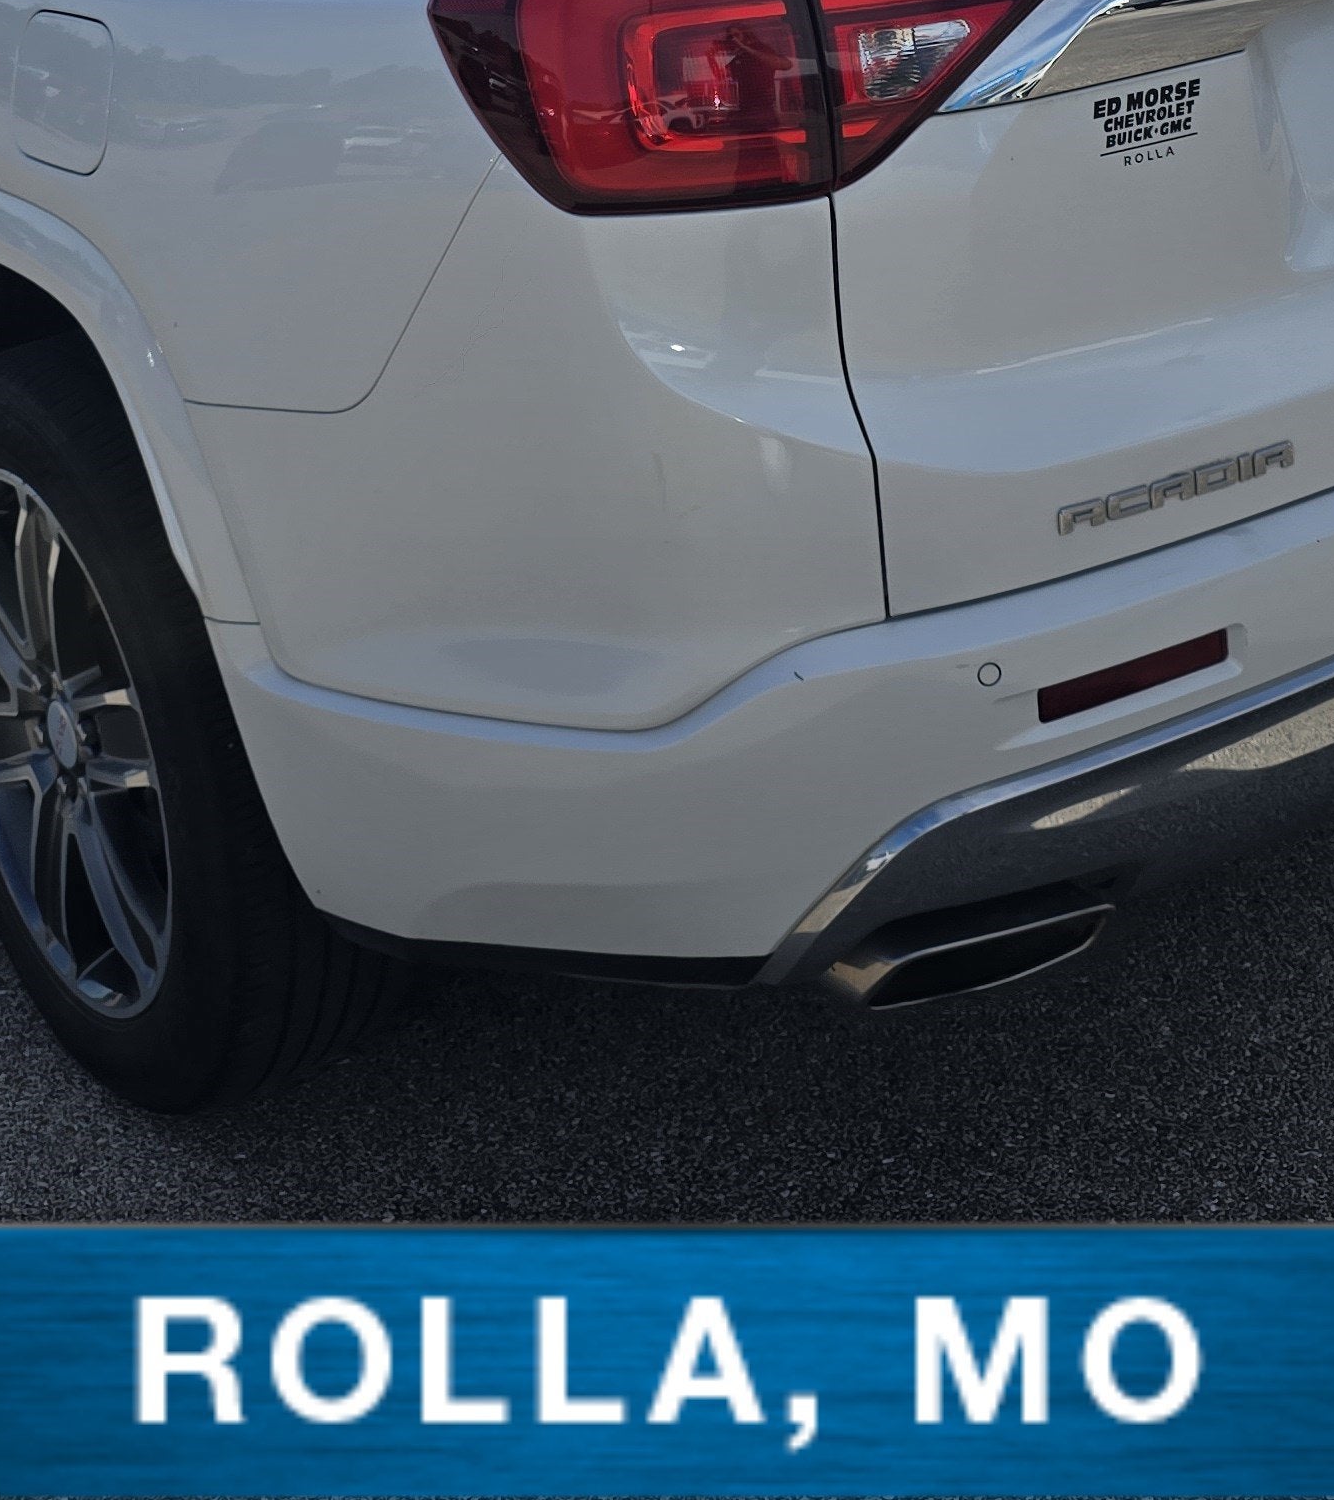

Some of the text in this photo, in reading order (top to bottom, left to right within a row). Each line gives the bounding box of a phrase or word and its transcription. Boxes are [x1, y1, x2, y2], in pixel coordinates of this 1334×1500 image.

[1093, 78, 1200, 119] ED MORSE
[1103, 100, 1194, 132] CHEVROLET
[1123, 146, 1175, 167] ROLLA
[1057, 439, 1295, 537] ACADIA
